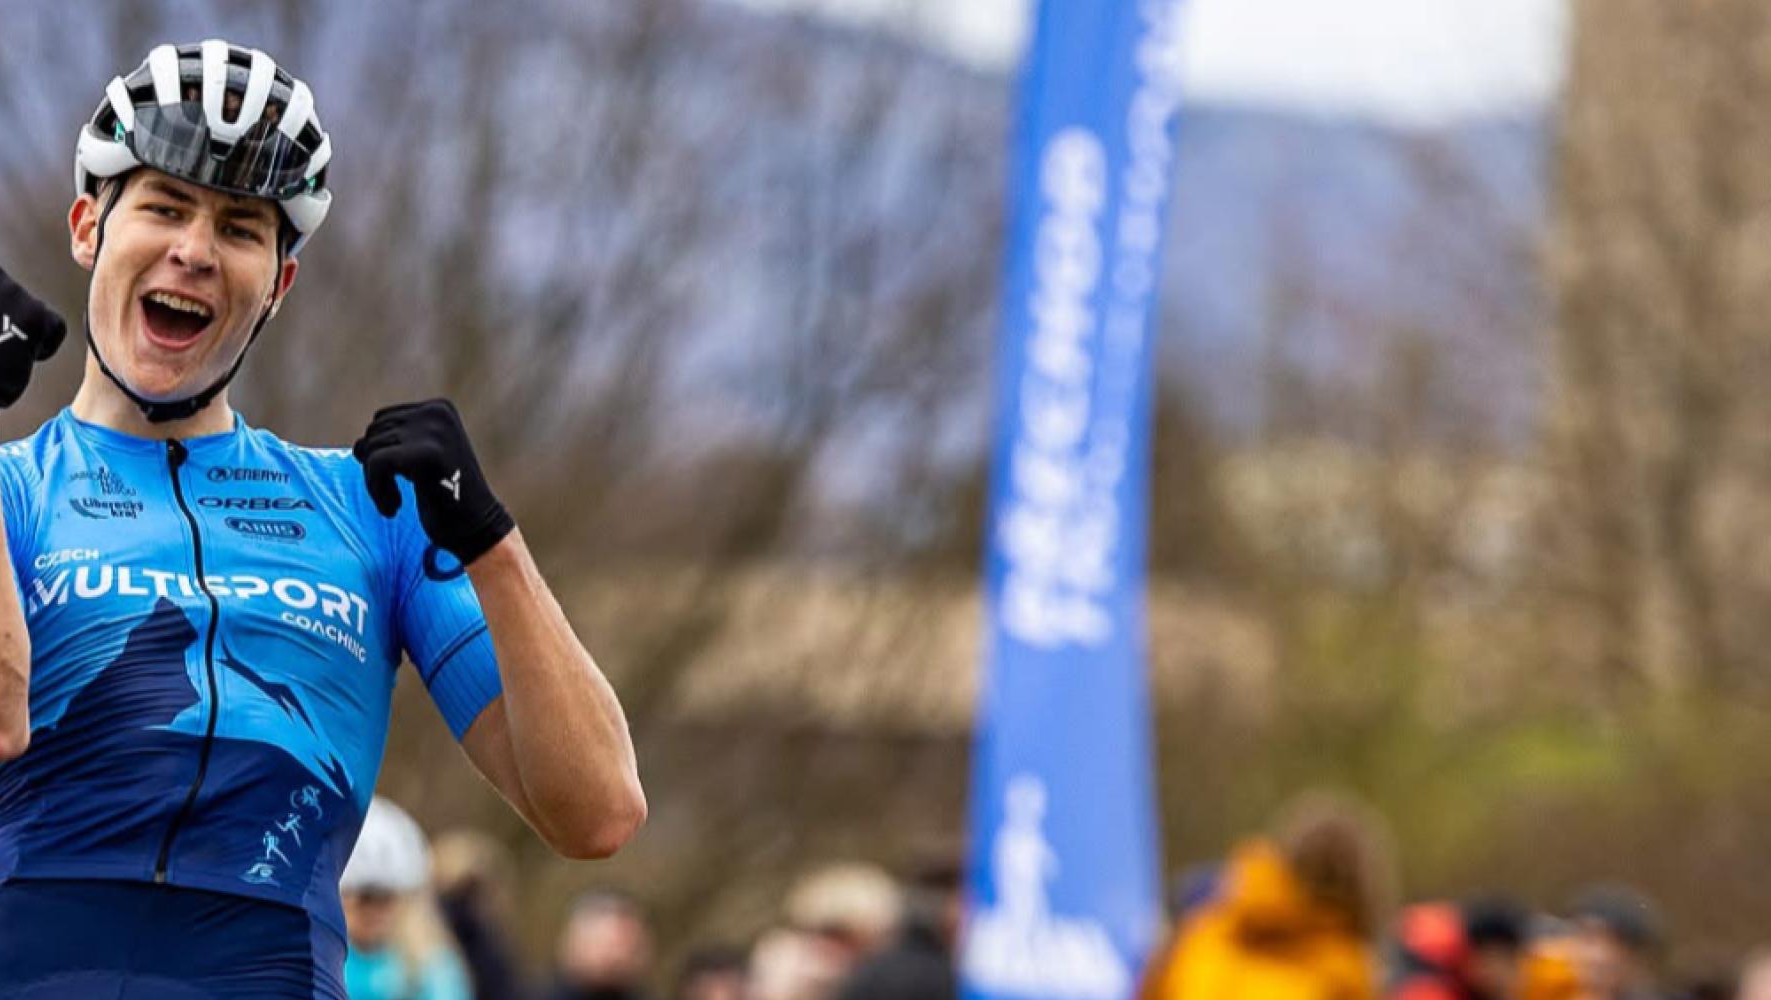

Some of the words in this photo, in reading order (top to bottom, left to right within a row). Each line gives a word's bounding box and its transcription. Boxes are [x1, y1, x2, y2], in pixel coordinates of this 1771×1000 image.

[198, 497, 315, 511] ORBEA
[34, 548, 99, 570] CZECH
[30, 564, 368, 635] MULTISPORT
